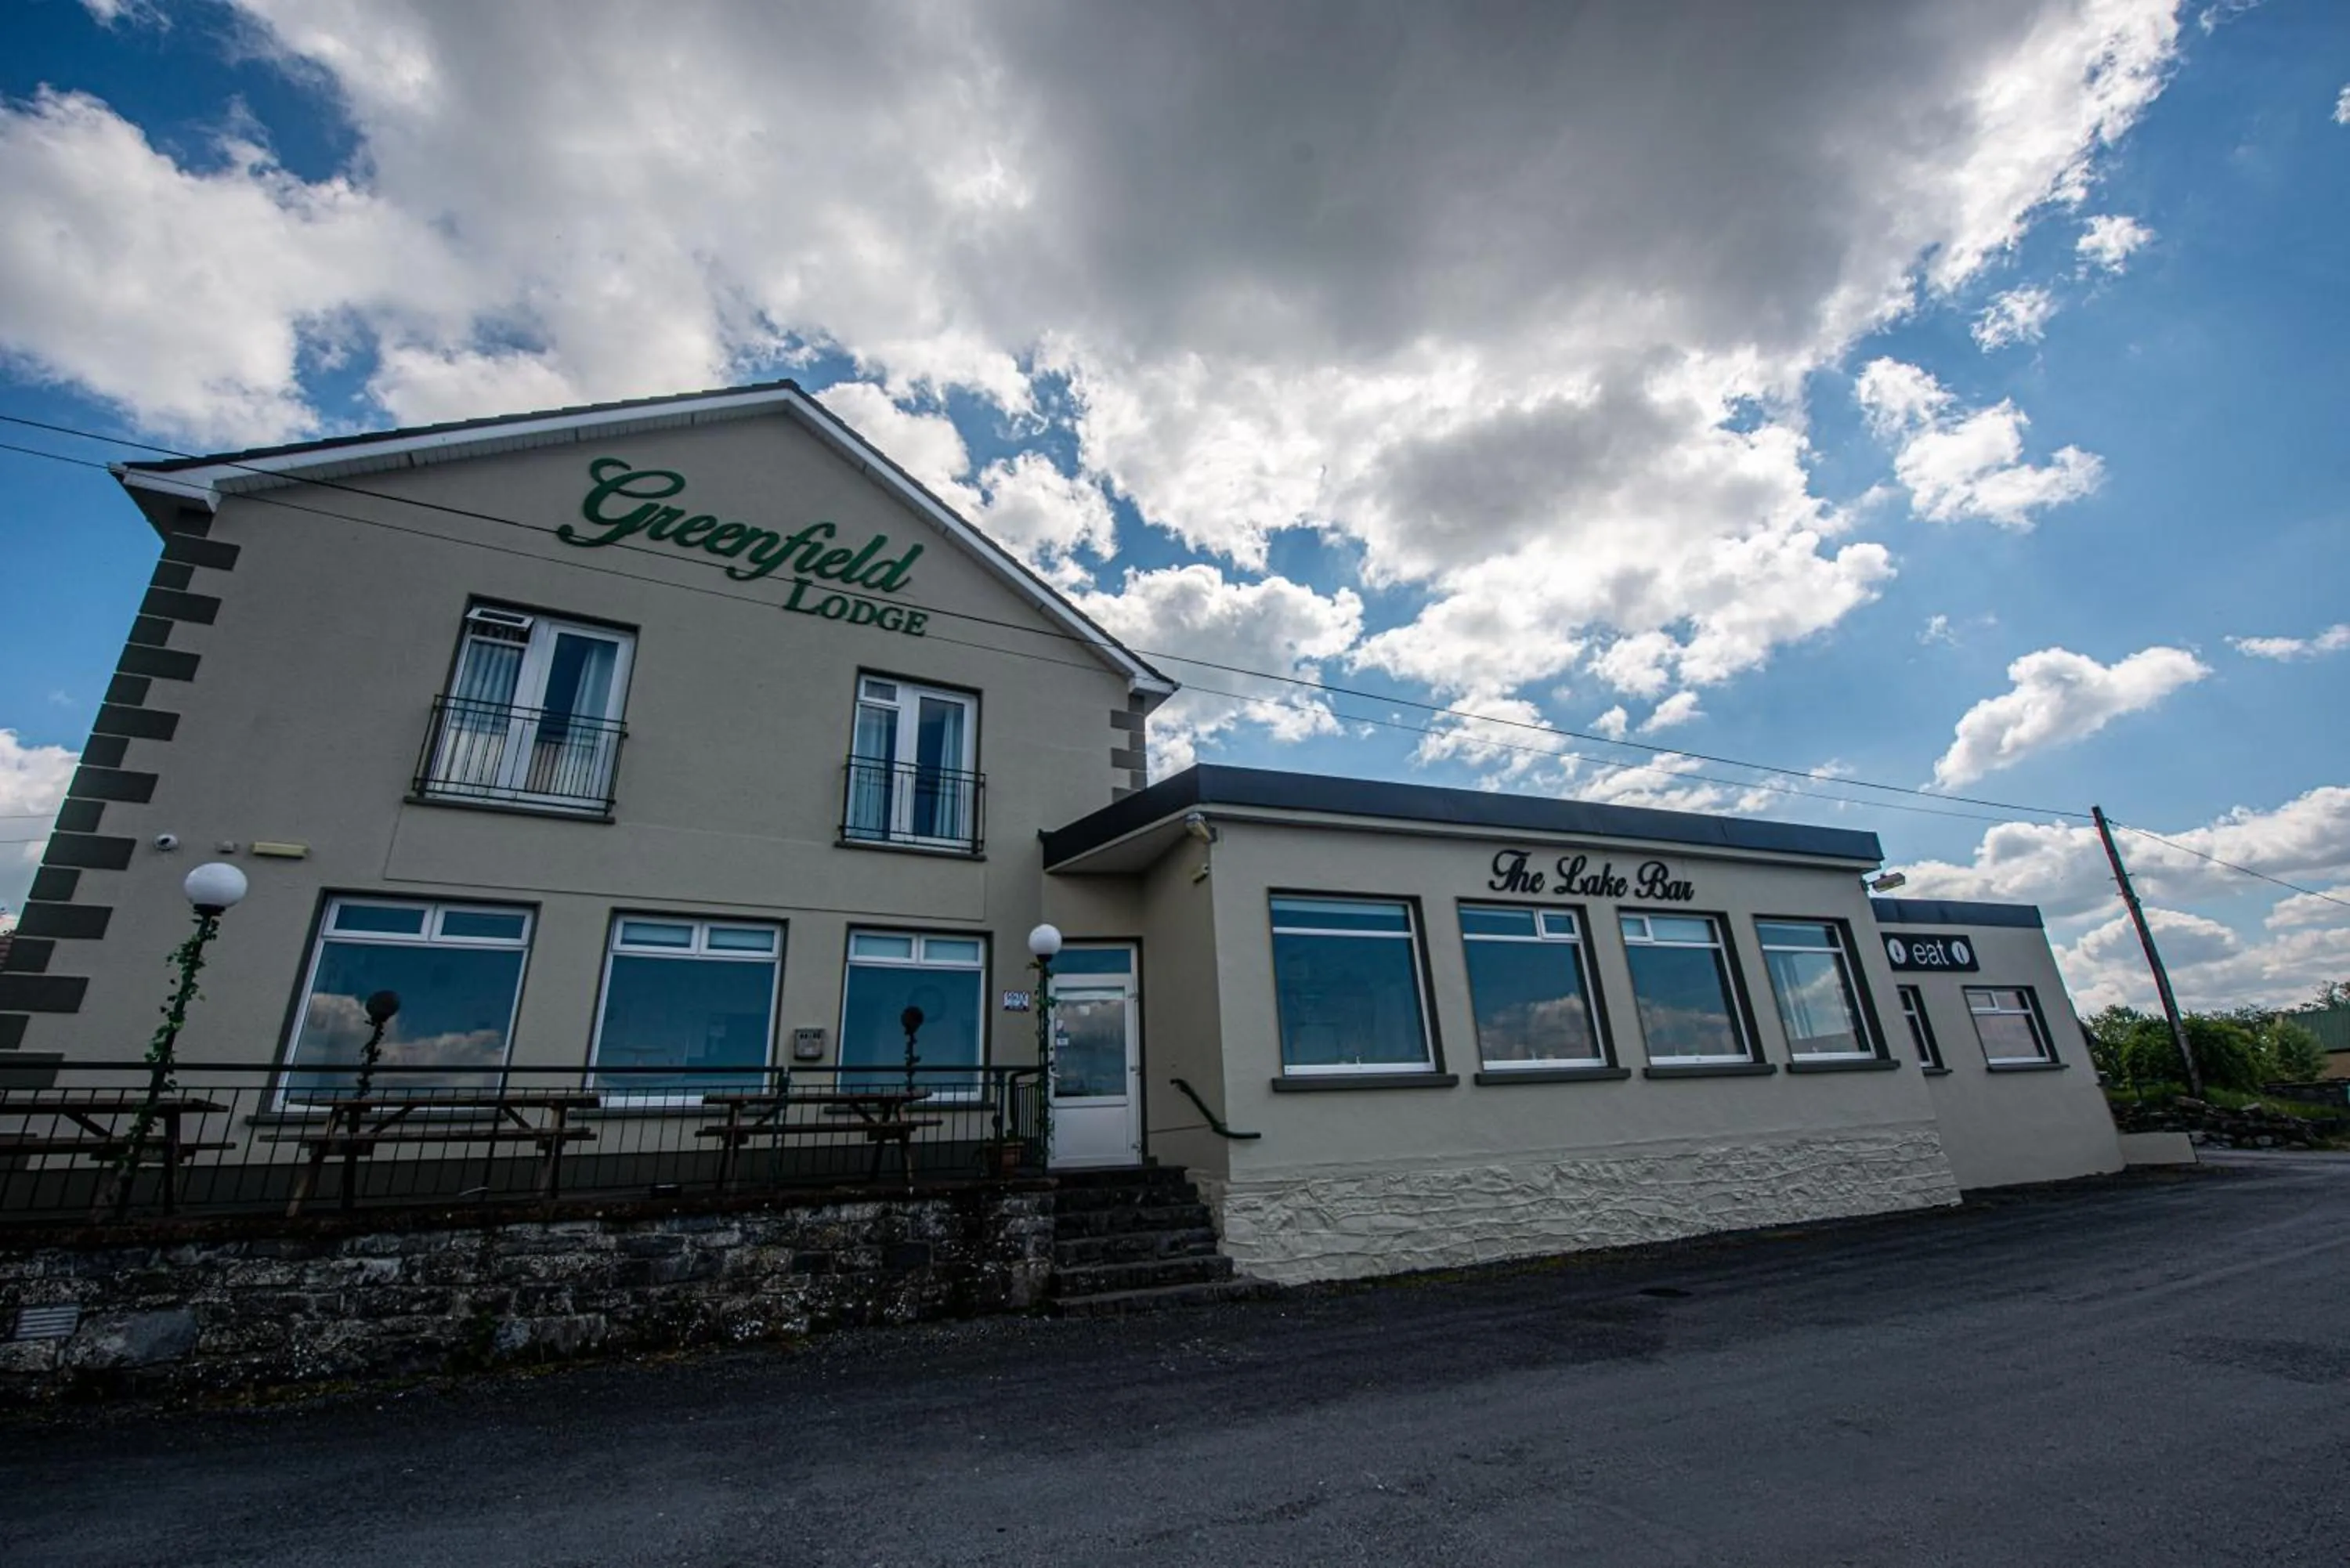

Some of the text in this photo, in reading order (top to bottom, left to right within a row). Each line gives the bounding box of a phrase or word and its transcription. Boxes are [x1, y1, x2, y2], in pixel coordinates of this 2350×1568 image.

[557, 457, 924, 593] Greenfield
[783, 577, 929, 637] LODGE
[1488, 849, 1694, 901] The Lake Bar
[1912, 940, 1950, 965] eat
